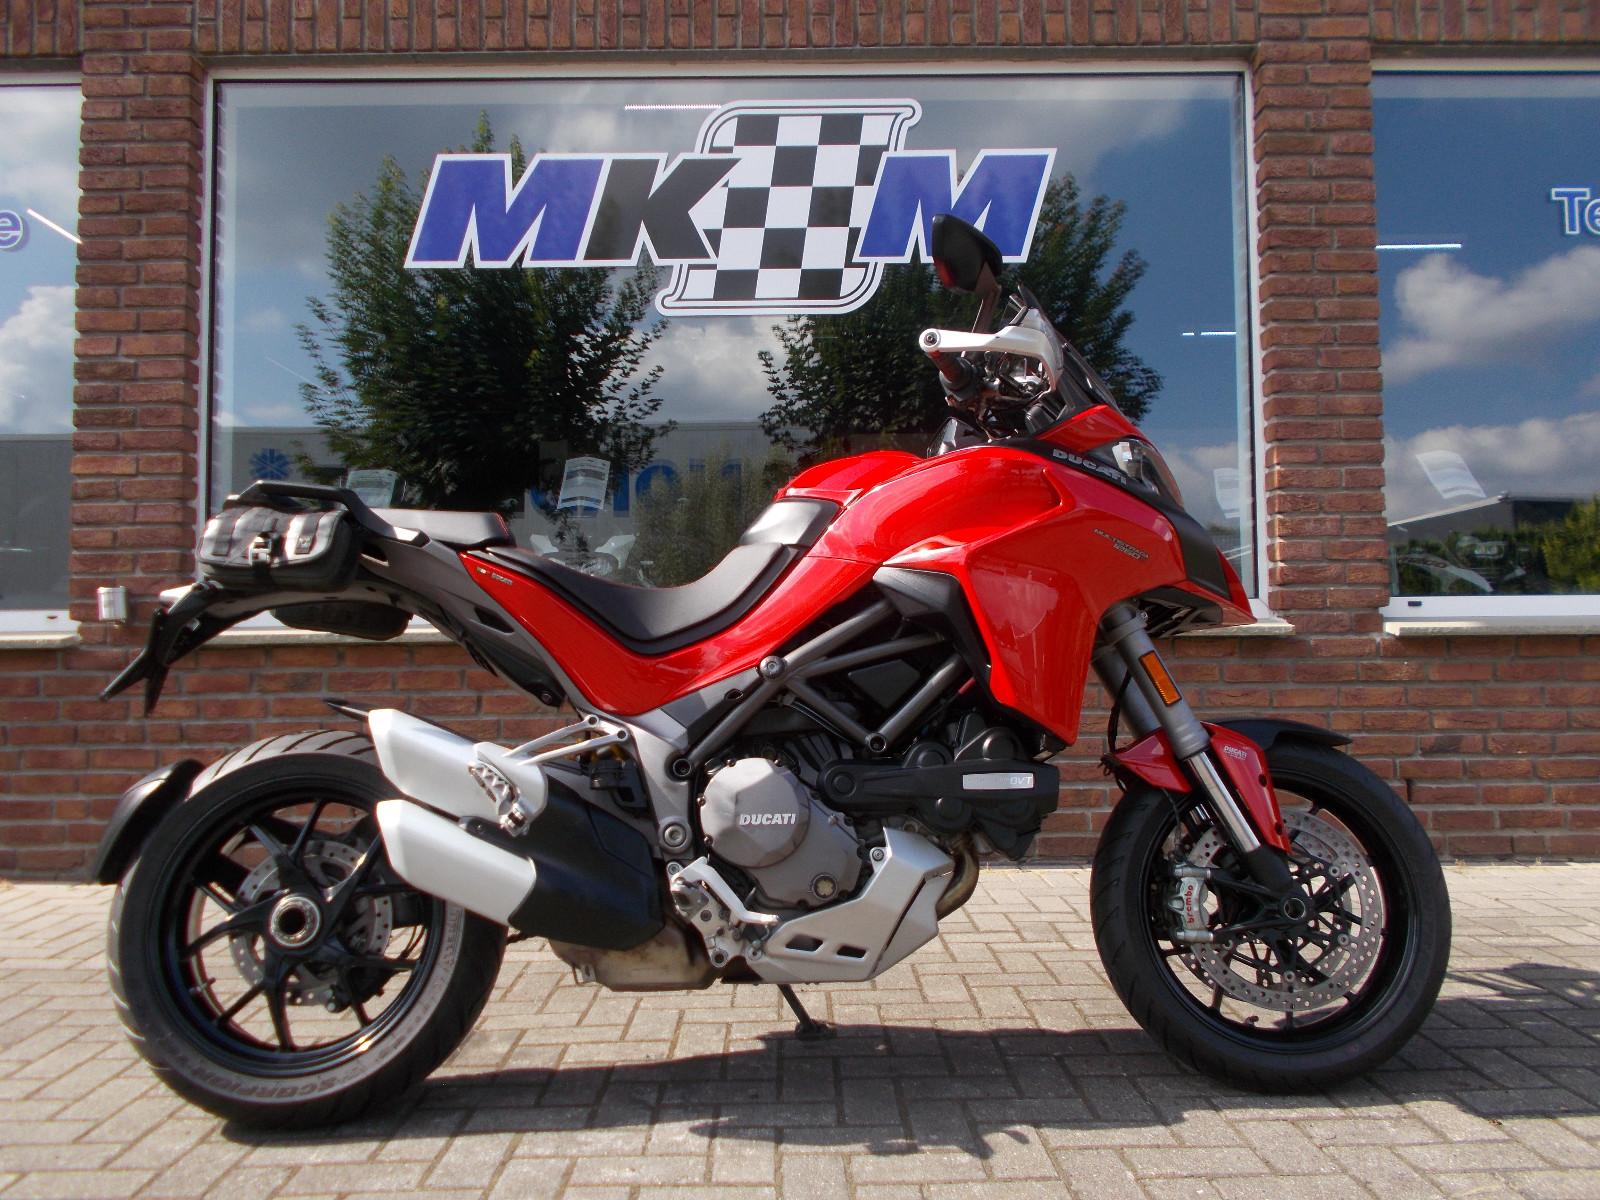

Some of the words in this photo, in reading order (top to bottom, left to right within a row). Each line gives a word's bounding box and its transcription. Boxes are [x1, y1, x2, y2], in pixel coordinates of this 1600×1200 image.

[1052, 448, 1127, 485] DUCATI
[739, 813, 797, 826] DUCATI
[1184, 884, 1195, 924] brembo
